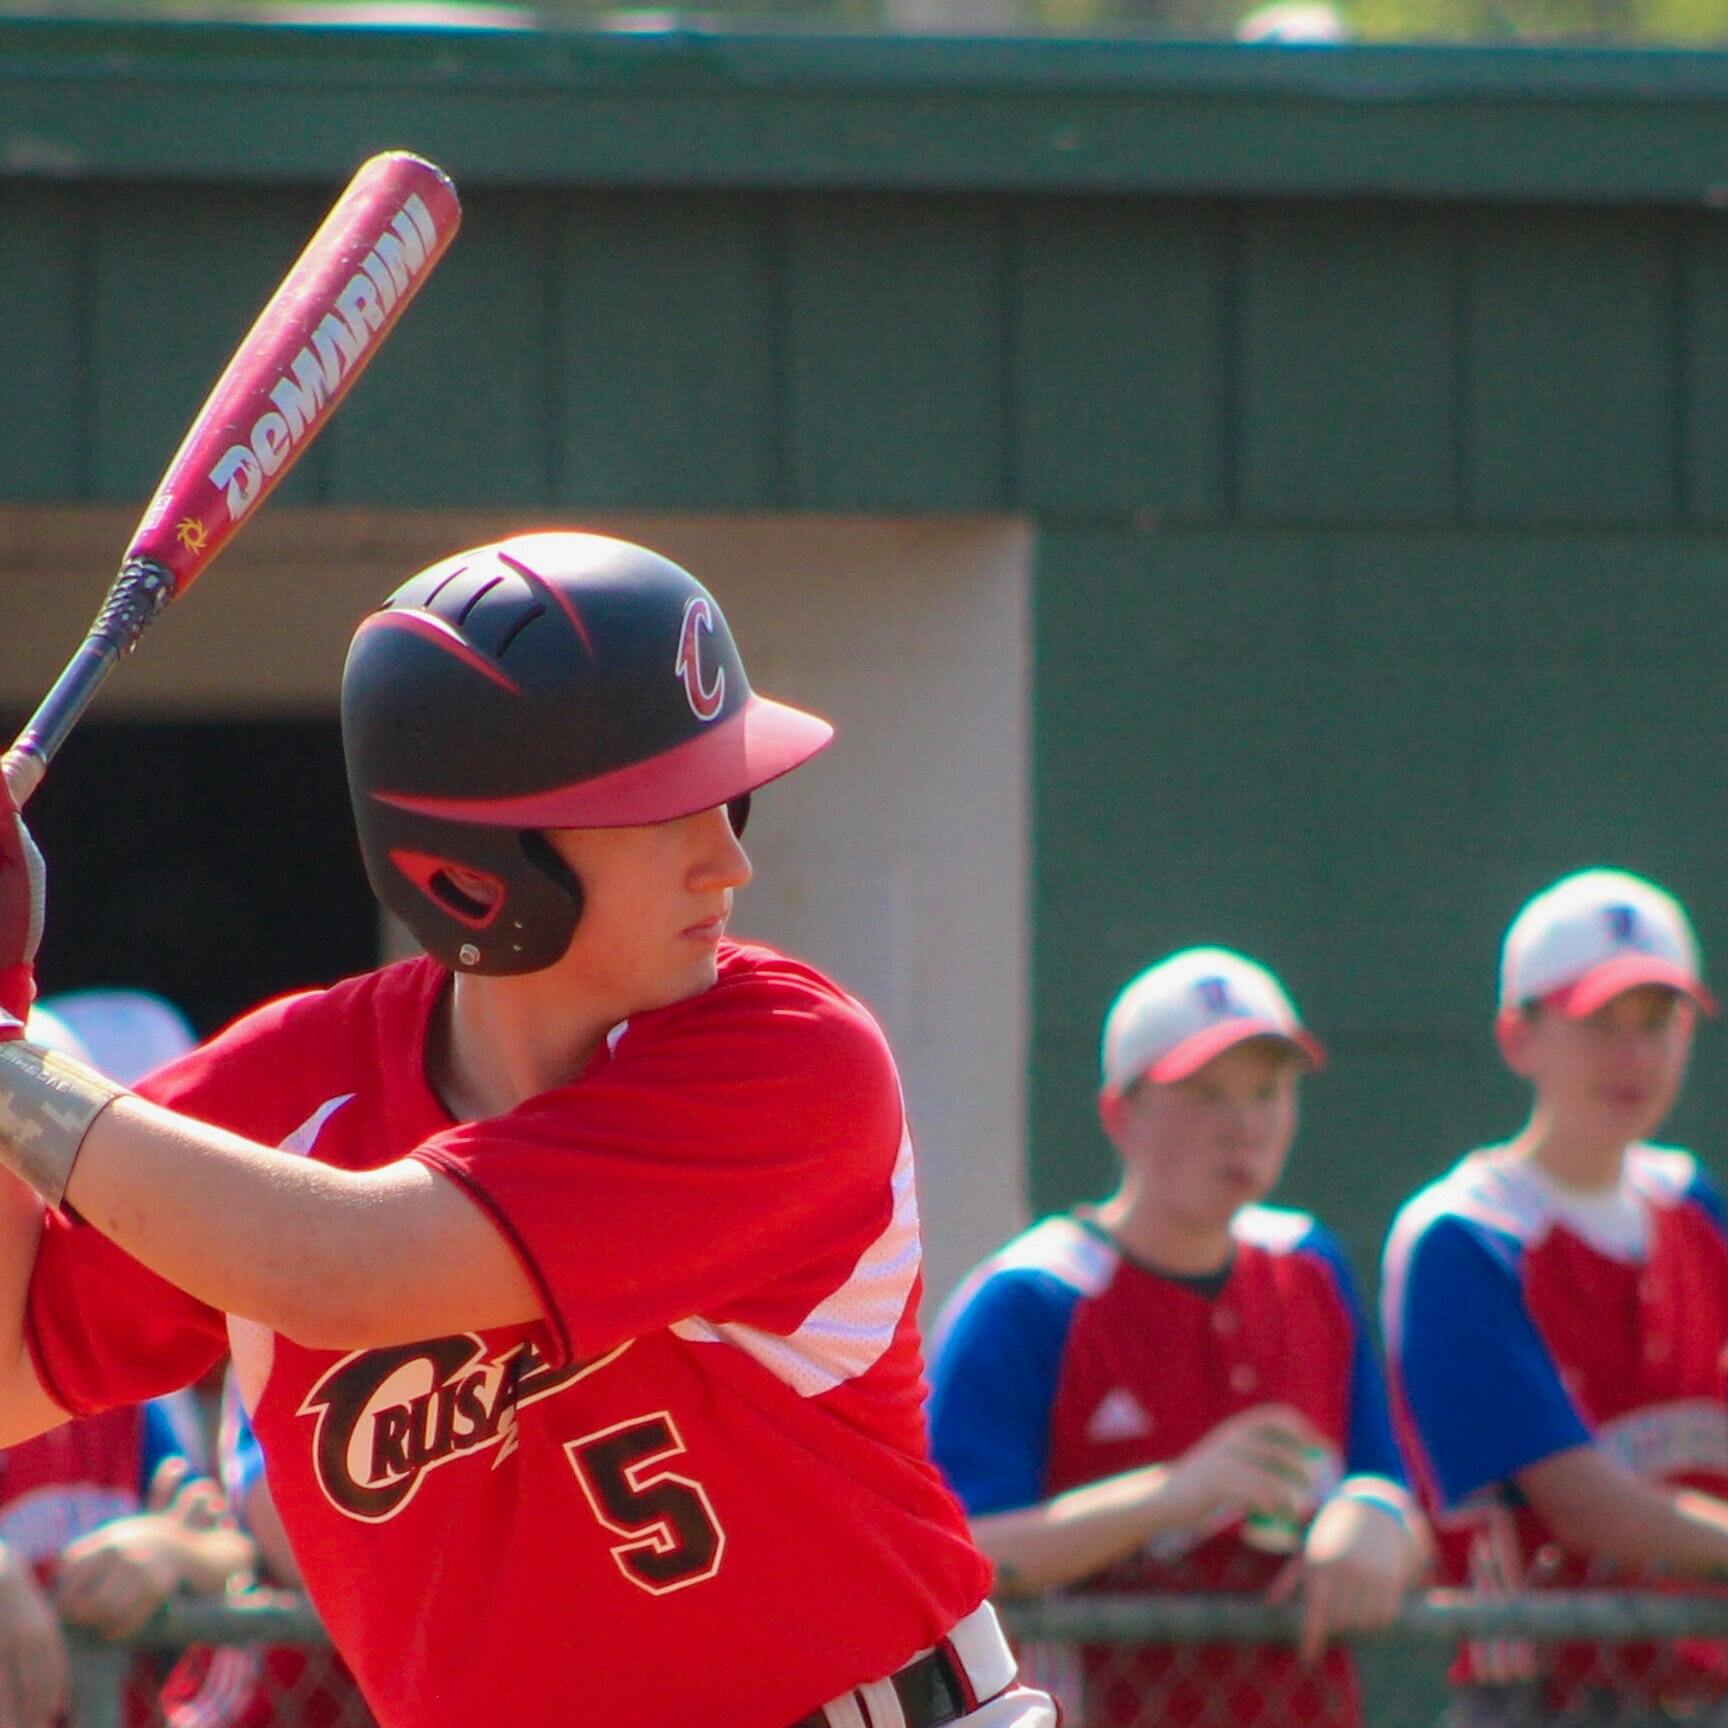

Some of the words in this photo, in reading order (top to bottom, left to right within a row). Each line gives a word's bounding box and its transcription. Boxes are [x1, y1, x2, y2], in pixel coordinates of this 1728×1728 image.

[209, 192, 438, 522] DeMARINI
[674, 596, 726, 722] C
[562, 1409, 726, 1596] 5
